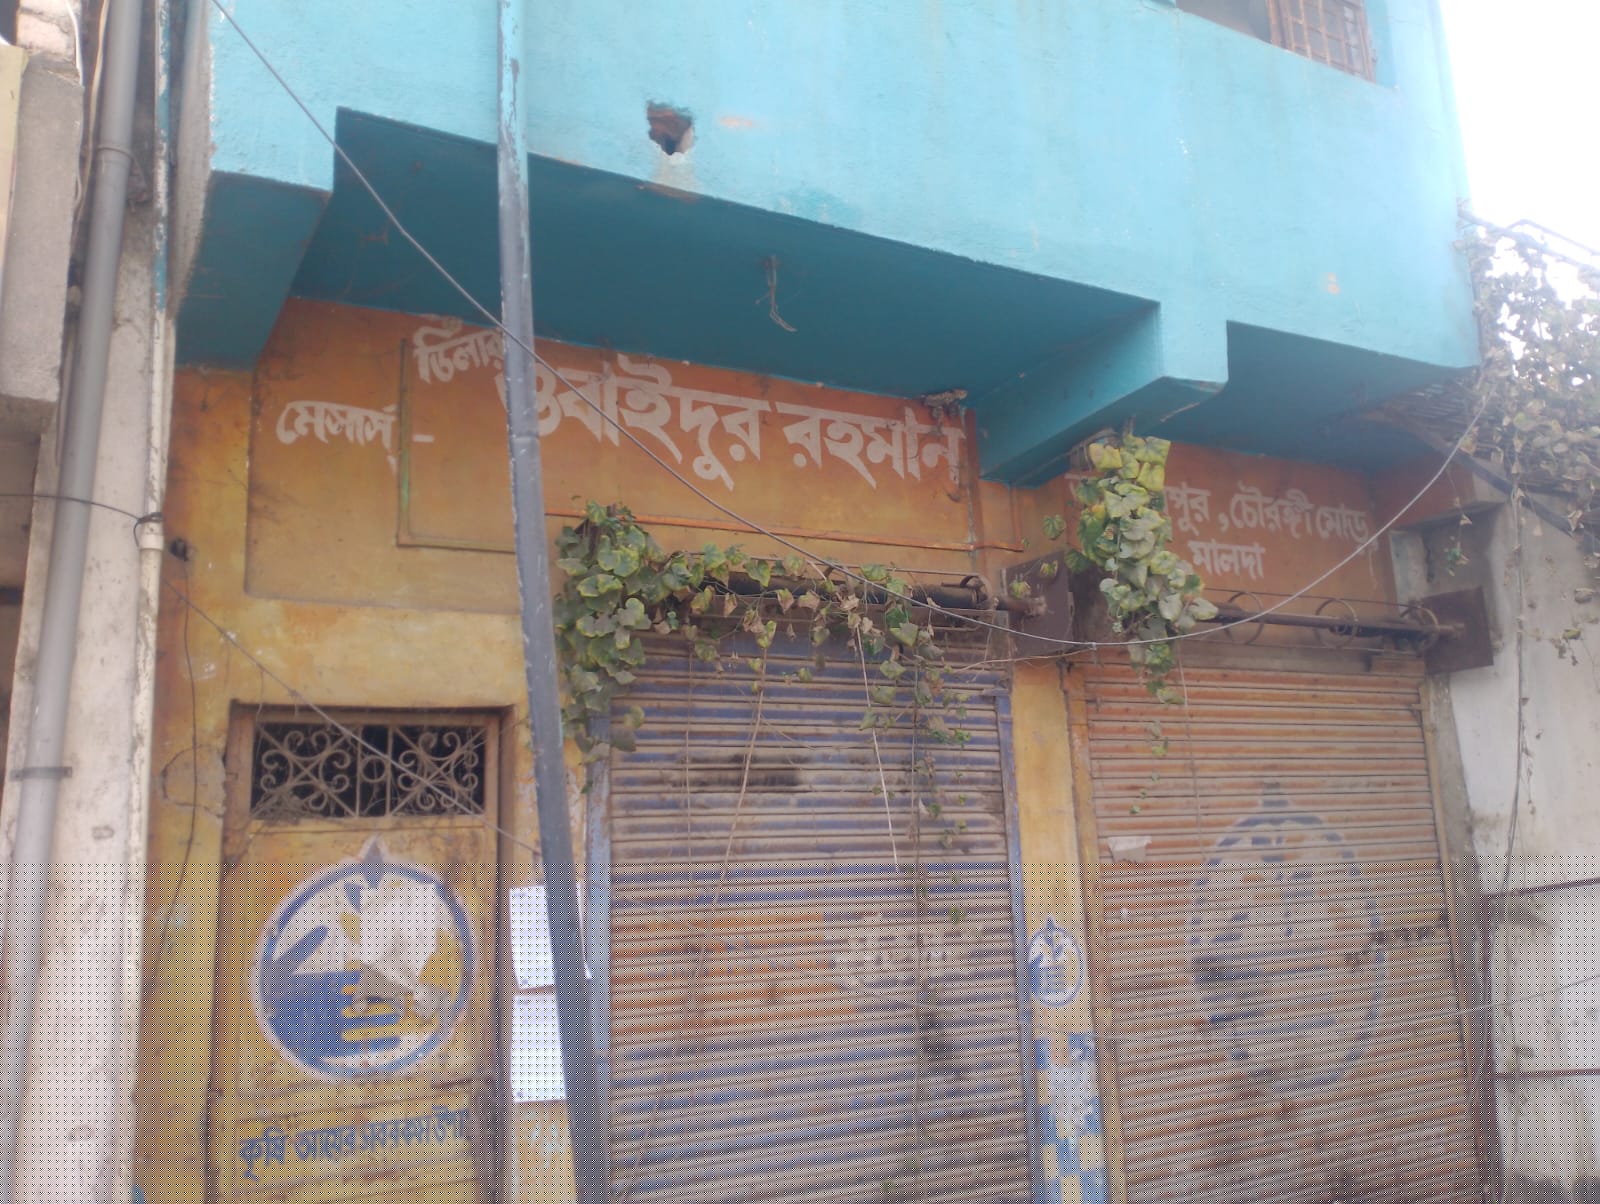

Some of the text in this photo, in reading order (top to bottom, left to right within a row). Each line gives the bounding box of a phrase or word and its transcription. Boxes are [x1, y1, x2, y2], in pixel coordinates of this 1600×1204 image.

[775, 401, 967, 489] রহমান
[1187, 538, 1266, 581] মালদা
[238, 1124, 287, 1182] কৃষি
